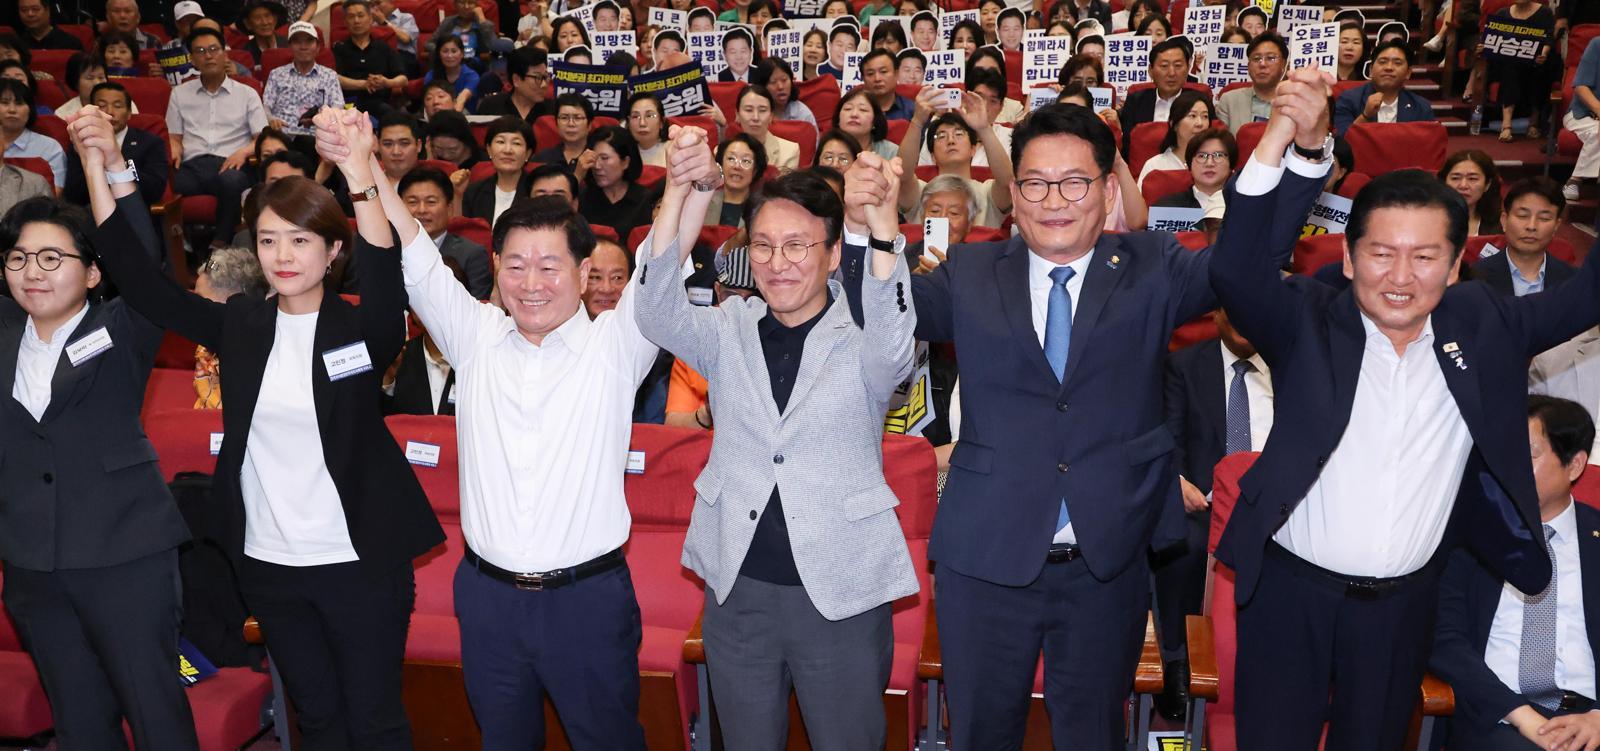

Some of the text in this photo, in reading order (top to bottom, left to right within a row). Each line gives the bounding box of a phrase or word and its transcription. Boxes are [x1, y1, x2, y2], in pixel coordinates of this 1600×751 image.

[655, 11, 664, 21] 더
[1188, 9, 1222, 20] 시장님
[1282, 8, 1321, 21] 언제나
[1187, 22, 1221, 34] 꽃길만
[1296, 25, 1335, 41] 오늘도
[595, 34, 632, 47] 희망찬
[771, 33, 787, 46] 광명의
[1027, 39, 1066, 51] 함께라서
[1108, 40, 1148, 52] 광명의
[1484, 33, 1539, 59] 박승원
[770, 46, 800, 58] 내일의
[1217, 46, 1244, 60] 함께
[1302, 41, 1328, 55] 응원
[931, 53, 954, 66] 시민
[1034, 54, 1058, 65] 든든
[1108, 55, 1148, 67] 자부심
[925, 67, 961, 81] 행복이
[1209, 62, 1248, 75] 만드는
[556, 70, 586, 82] 자치분권
[1108, 70, 1147, 82] 밝은내일
[634, 79, 666, 93] 자치분권
[661, 84, 705, 117] 승원
[1313, 204, 1350, 225] 형발전
